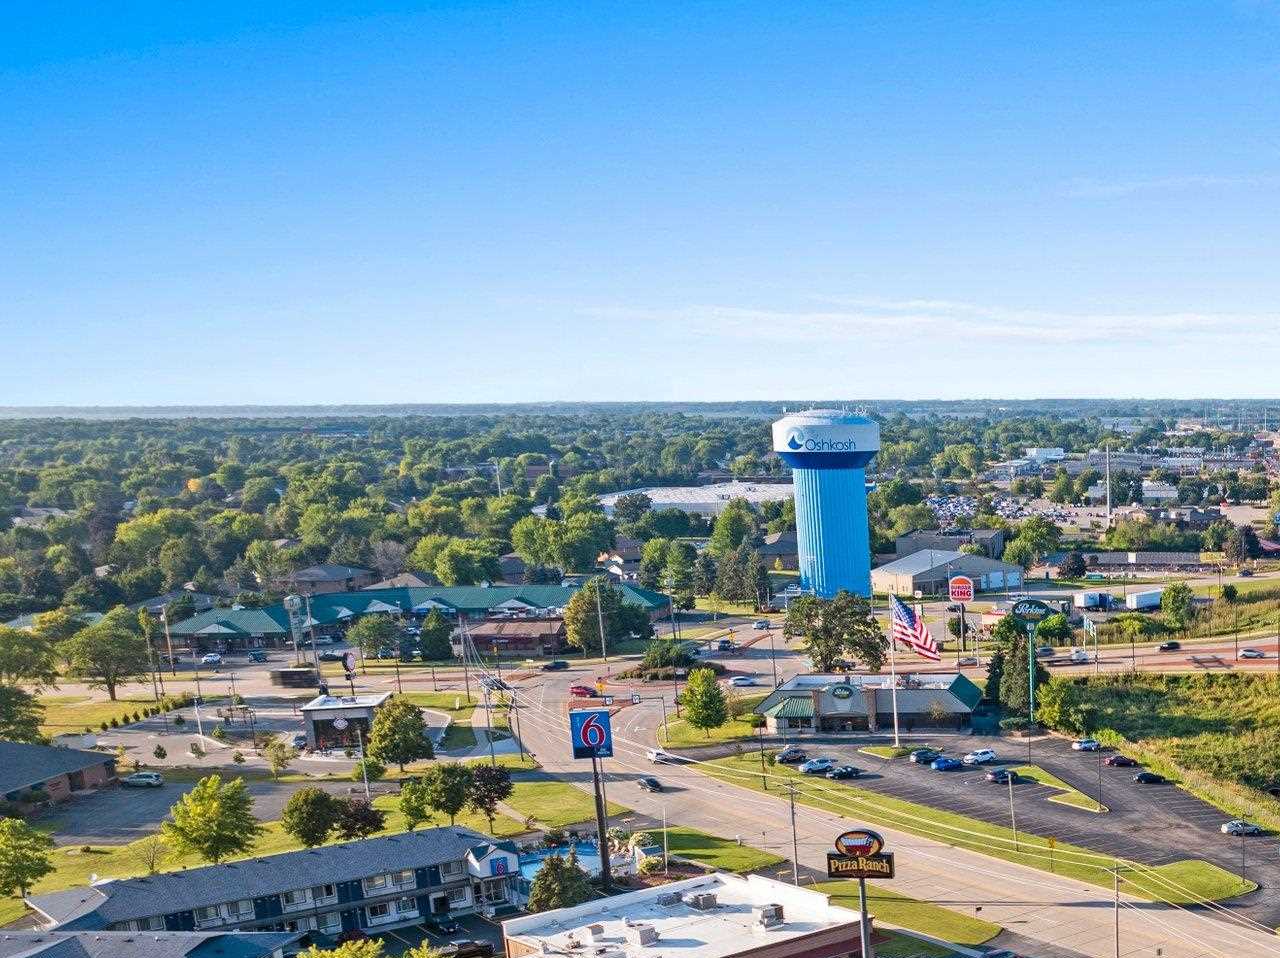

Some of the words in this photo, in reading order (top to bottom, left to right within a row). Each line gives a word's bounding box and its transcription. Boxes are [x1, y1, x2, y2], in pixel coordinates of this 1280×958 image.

[805, 438, 856, 451] Oshkosh
[580, 713, 606, 749] 6
[831, 859, 858, 872] Pizza
[858, 857, 890, 873] Ranch
